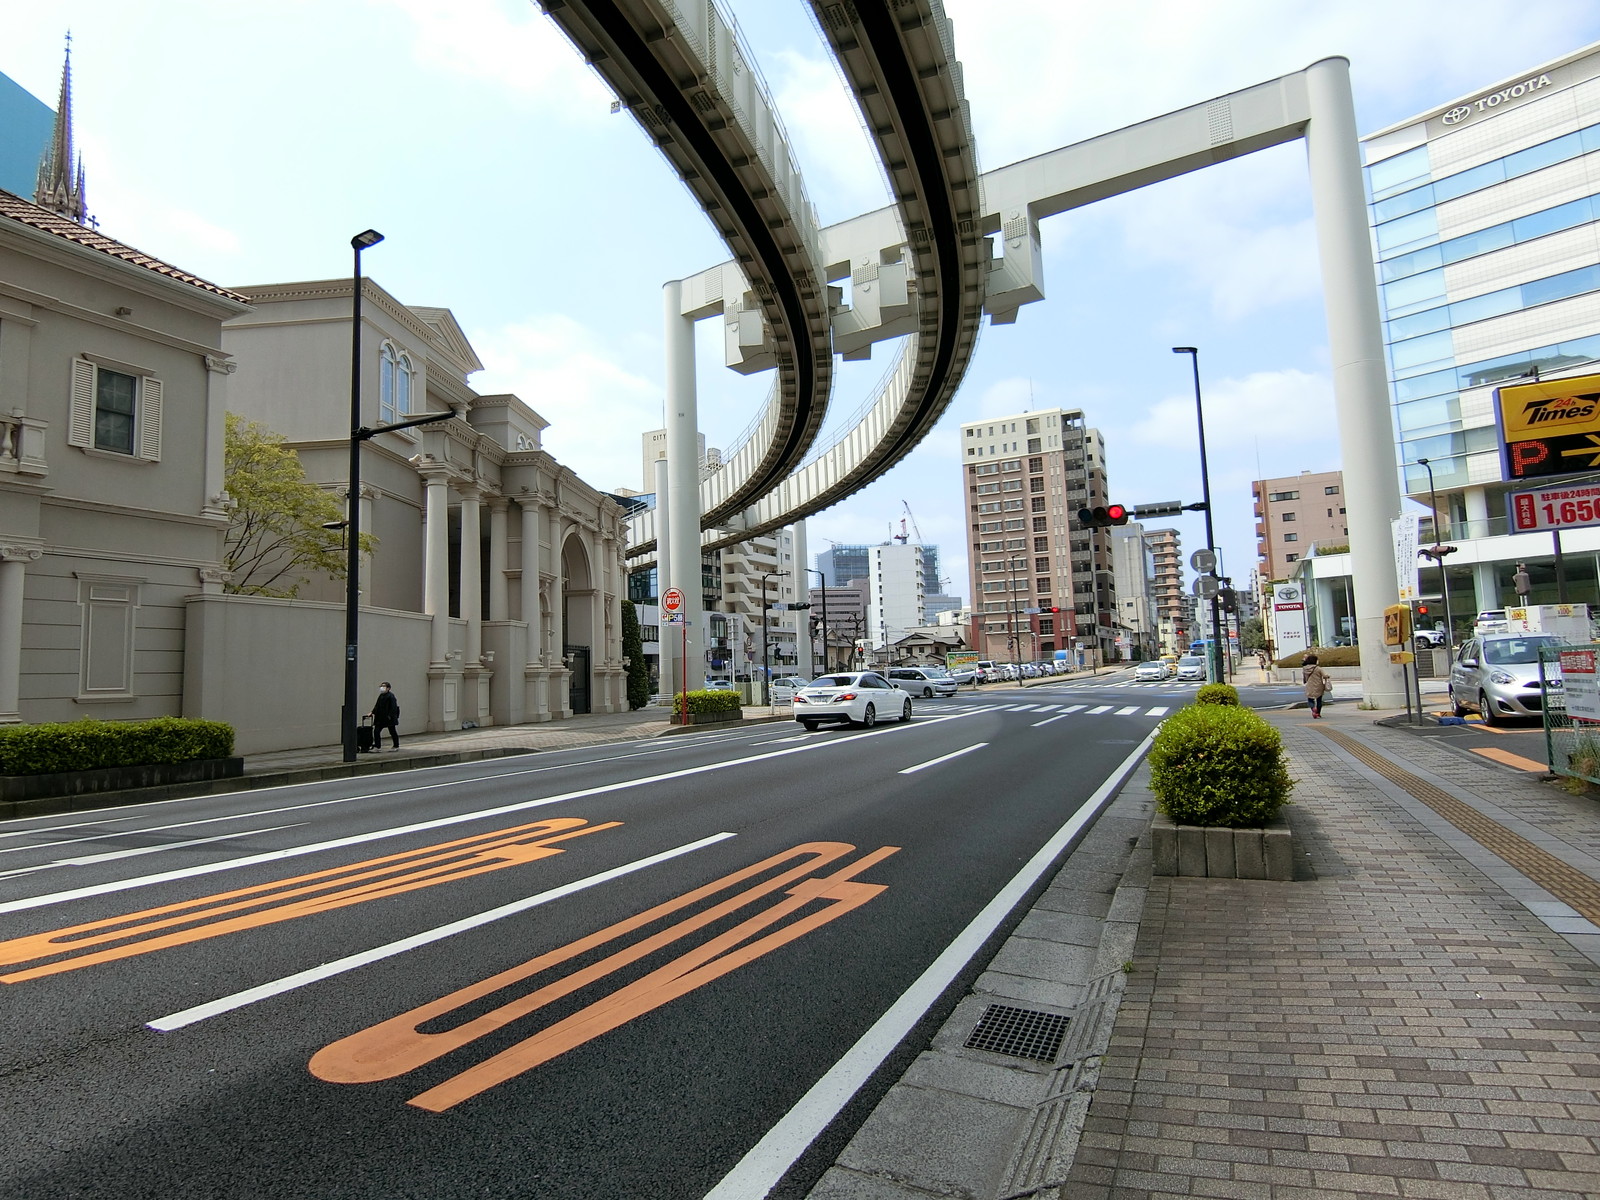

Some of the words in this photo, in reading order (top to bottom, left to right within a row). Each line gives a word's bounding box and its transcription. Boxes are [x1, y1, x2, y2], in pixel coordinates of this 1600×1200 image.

[1475, 73, 1552, 112] TOYOTA
[1523, 399, 1596, 425] Times
[652, 433, 667, 442] CITY
[1512, 441, 1548, 476] P
